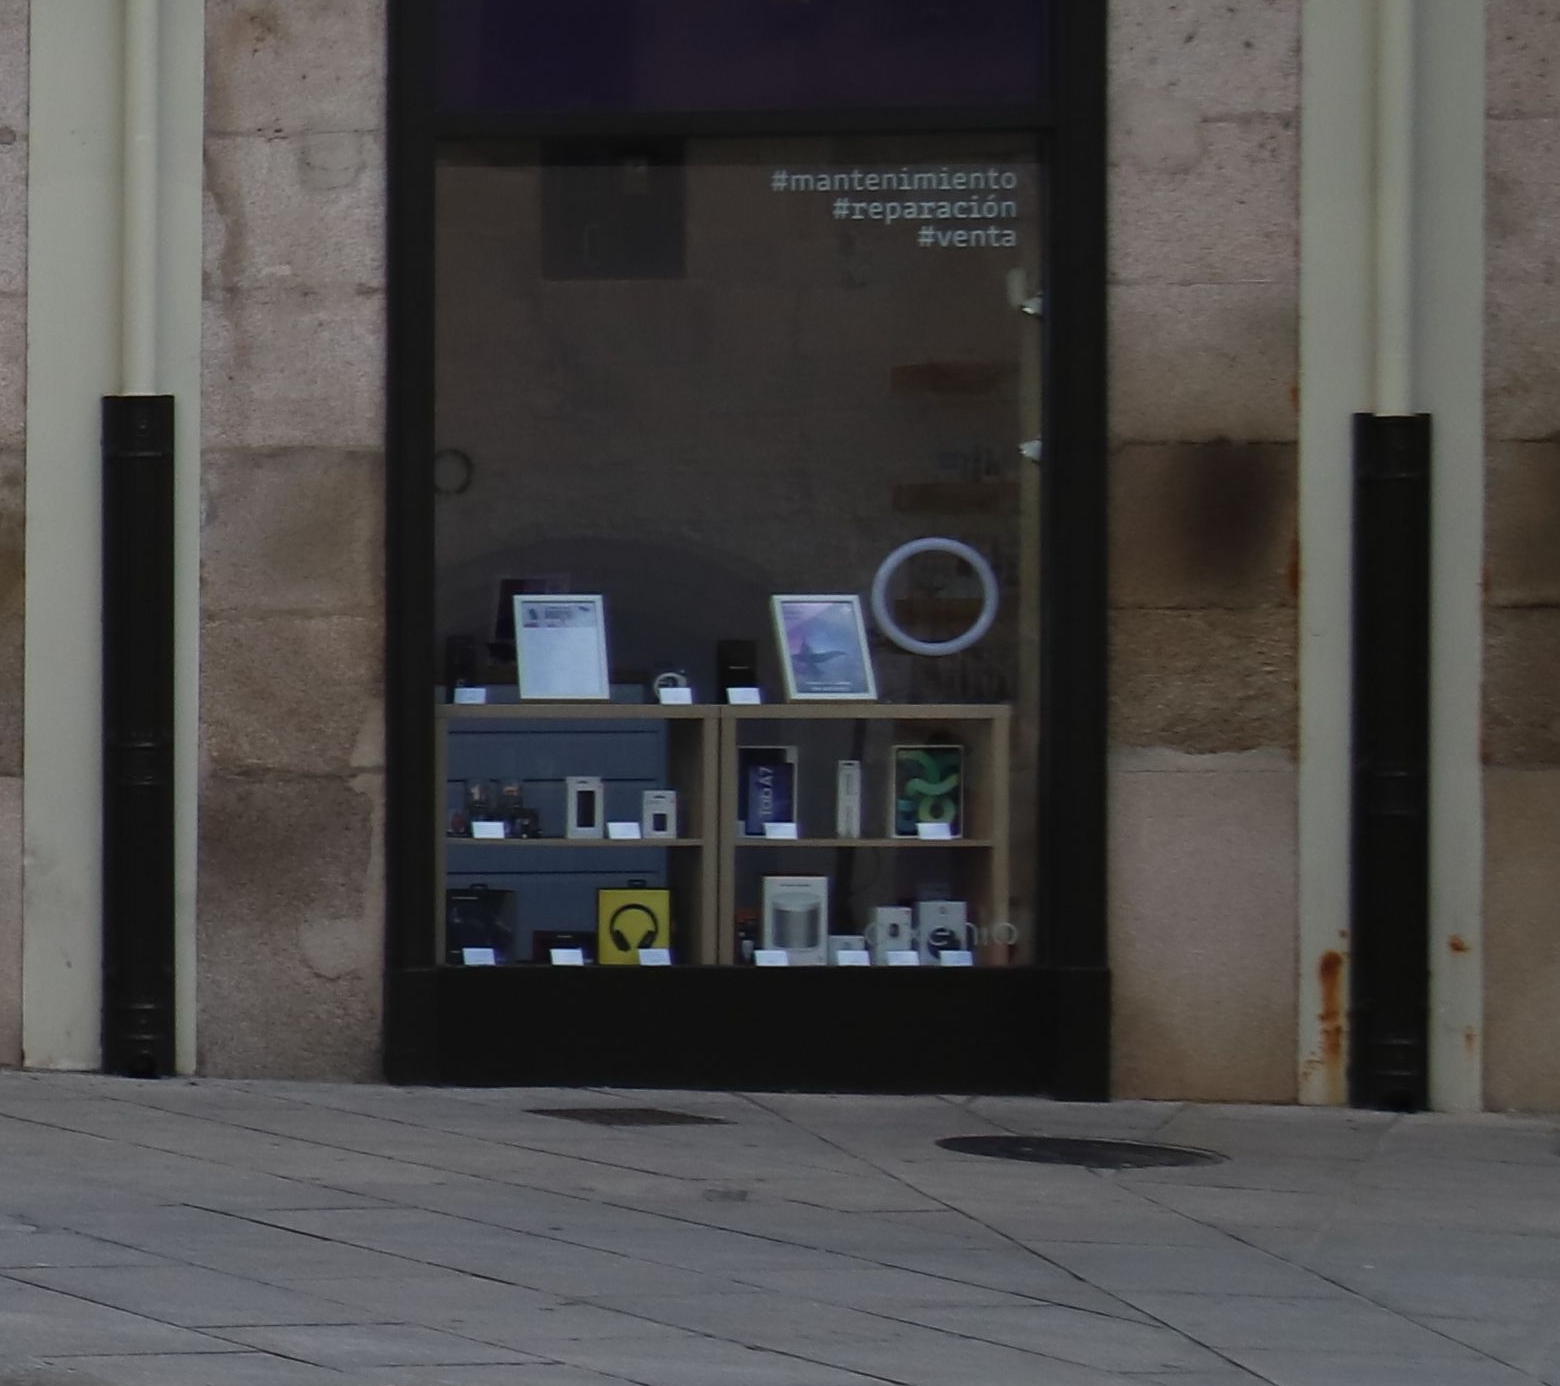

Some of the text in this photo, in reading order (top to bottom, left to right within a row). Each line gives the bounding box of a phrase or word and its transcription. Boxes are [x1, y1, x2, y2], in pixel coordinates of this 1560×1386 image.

[771, 169, 1017, 192] #mantenimiento
[833, 194, 1017, 222] #reparación
[918, 225, 1017, 248] #venta
